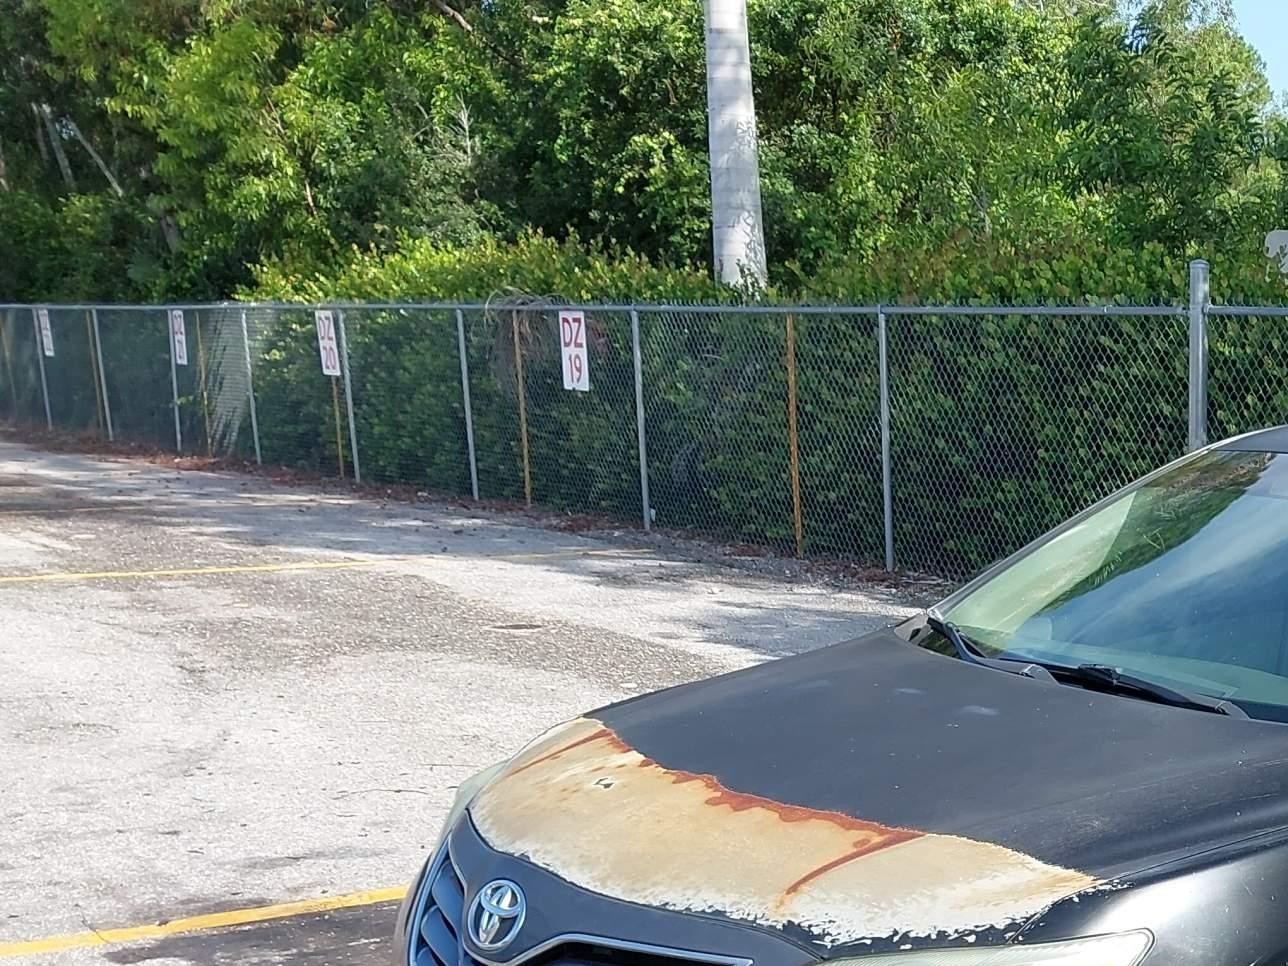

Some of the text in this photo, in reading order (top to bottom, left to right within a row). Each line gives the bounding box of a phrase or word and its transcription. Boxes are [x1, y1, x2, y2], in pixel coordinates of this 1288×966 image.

[318, 316, 334, 341] DZ
[562, 317, 583, 348] DZ
[322, 346, 336, 370] 20
[568, 354, 583, 384] 19
